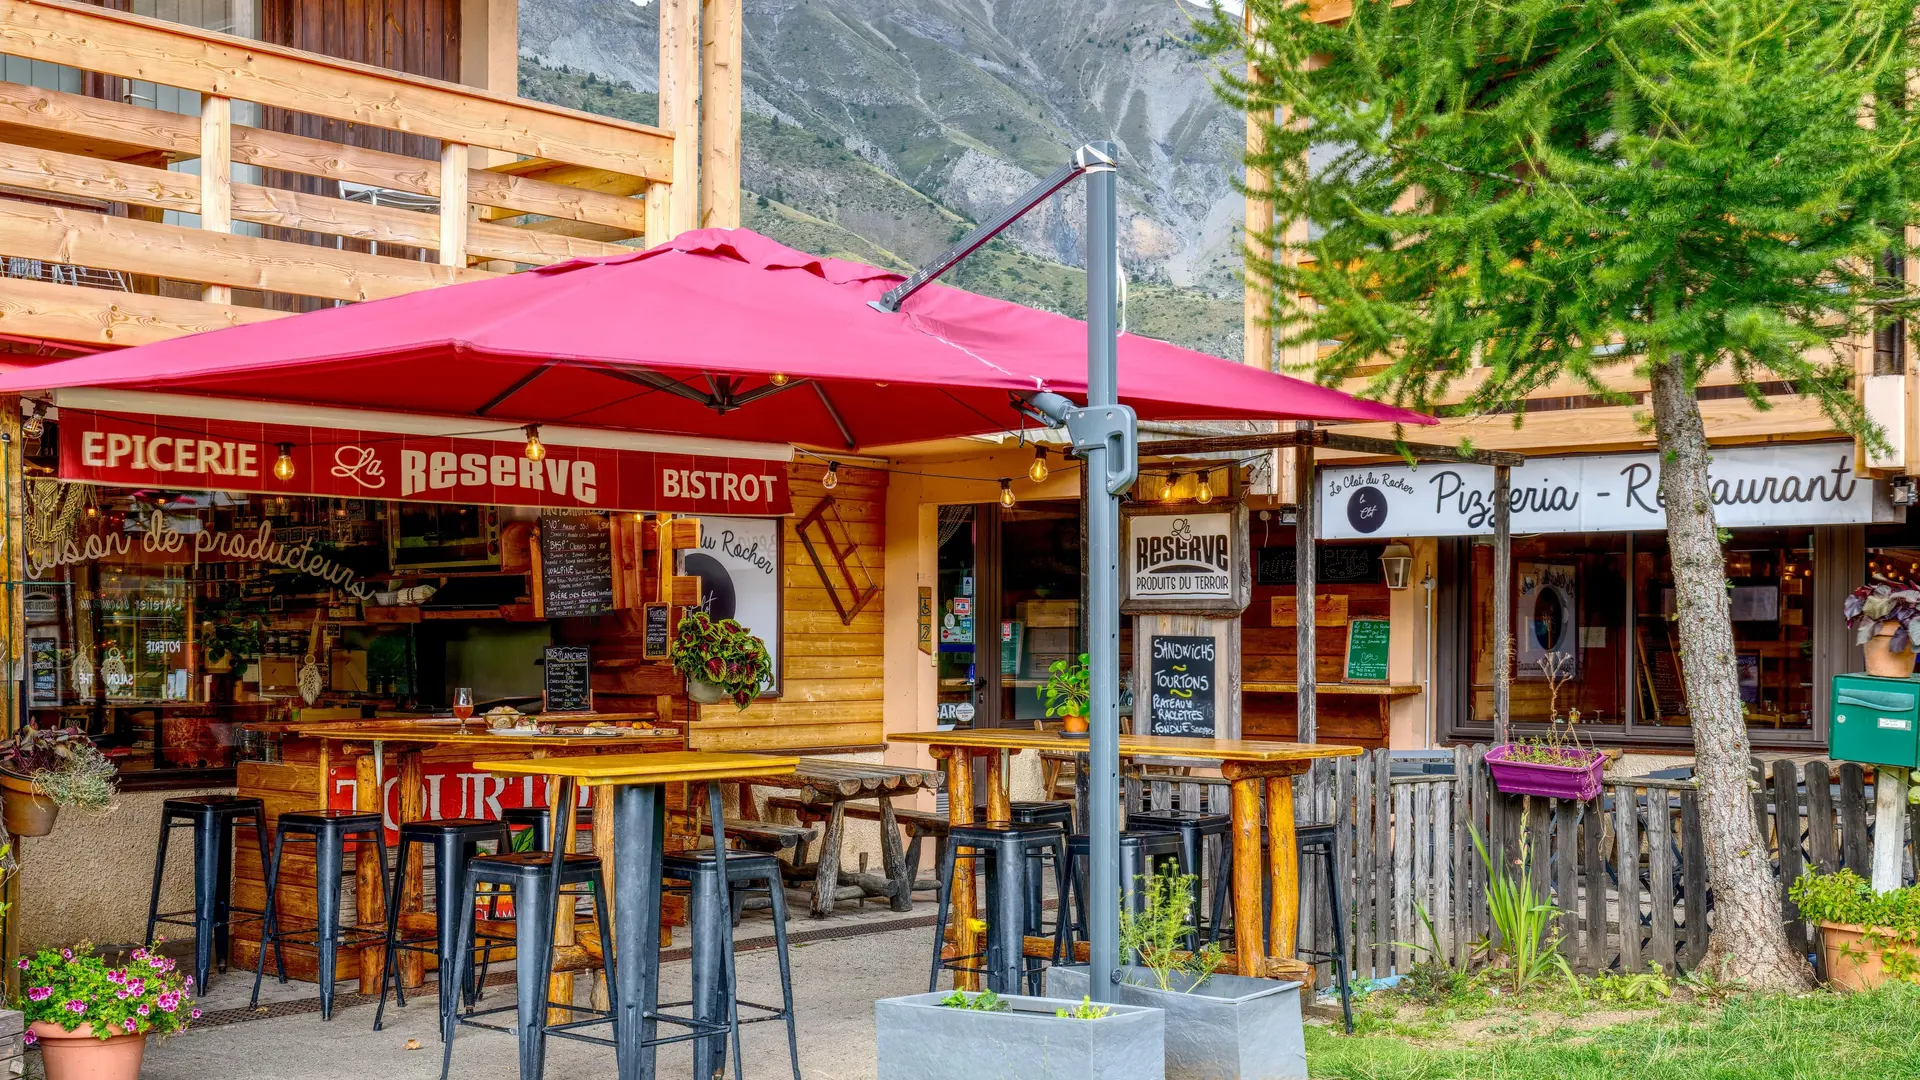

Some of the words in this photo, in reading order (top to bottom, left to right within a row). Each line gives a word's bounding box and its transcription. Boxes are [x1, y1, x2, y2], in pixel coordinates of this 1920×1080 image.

[82, 431, 259, 477] EPICERIE
[331, 445, 385, 489] La
[663, 468, 777, 502] BISTROT
[1329, 481, 1342, 496] Le
[1344, 474, 1364, 488] Clot
[1366, 472, 1379, 485] du
[1382, 473, 1414, 494] Rocher
[1620, 455, 1856, 513] Raurant
[1171, 518, 1192, 541] La
[143, 509, 184, 552] de
[195, 519, 376, 600] producteurs
[721, 530, 774, 575] Rocher
[1324, 549, 1369, 562] PIZZA
[1136, 577, 1176, 590] PRODUITS
[1180, 576, 1191, 590] DU
[1194, 575, 1228, 590] TERROIR
[1154, 670, 1209, 691] TOURTONS
[1155, 722, 1191, 734] FONDUE
